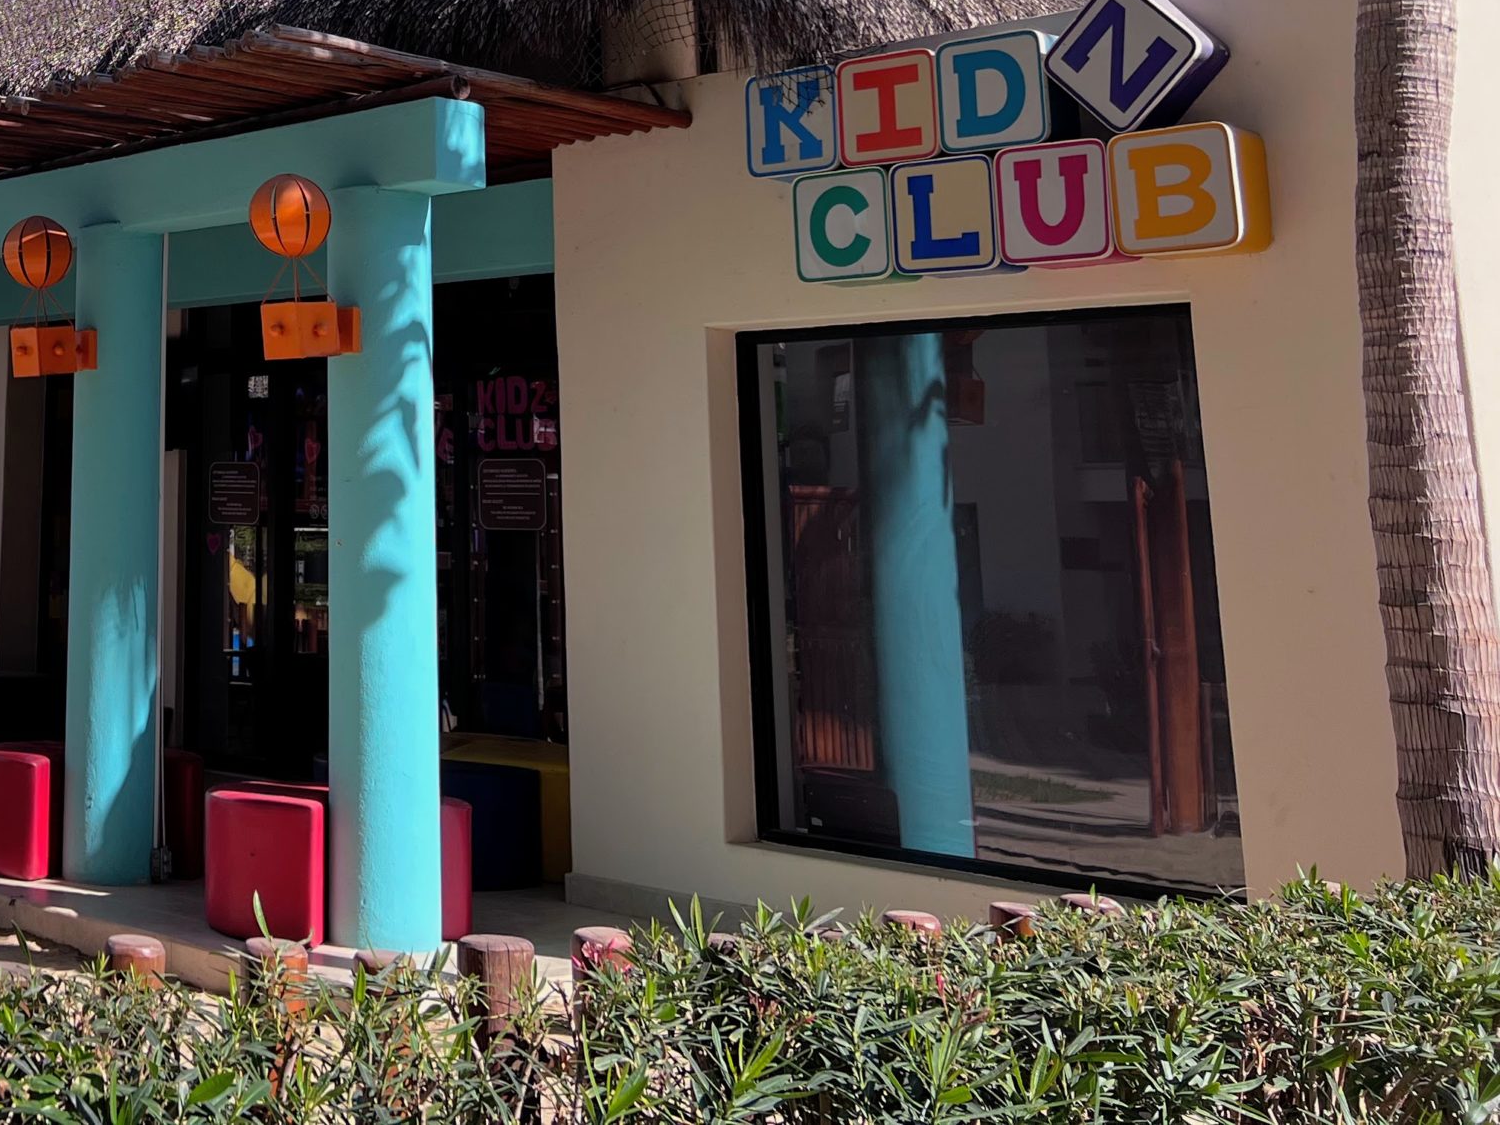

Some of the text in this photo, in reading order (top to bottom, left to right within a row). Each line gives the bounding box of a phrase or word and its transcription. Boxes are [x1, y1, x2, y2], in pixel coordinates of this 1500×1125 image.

[809, 143, 1218, 267] CLUB
[476, 376, 549, 416] KIDZ
[476, 414, 558, 452] CLUB
